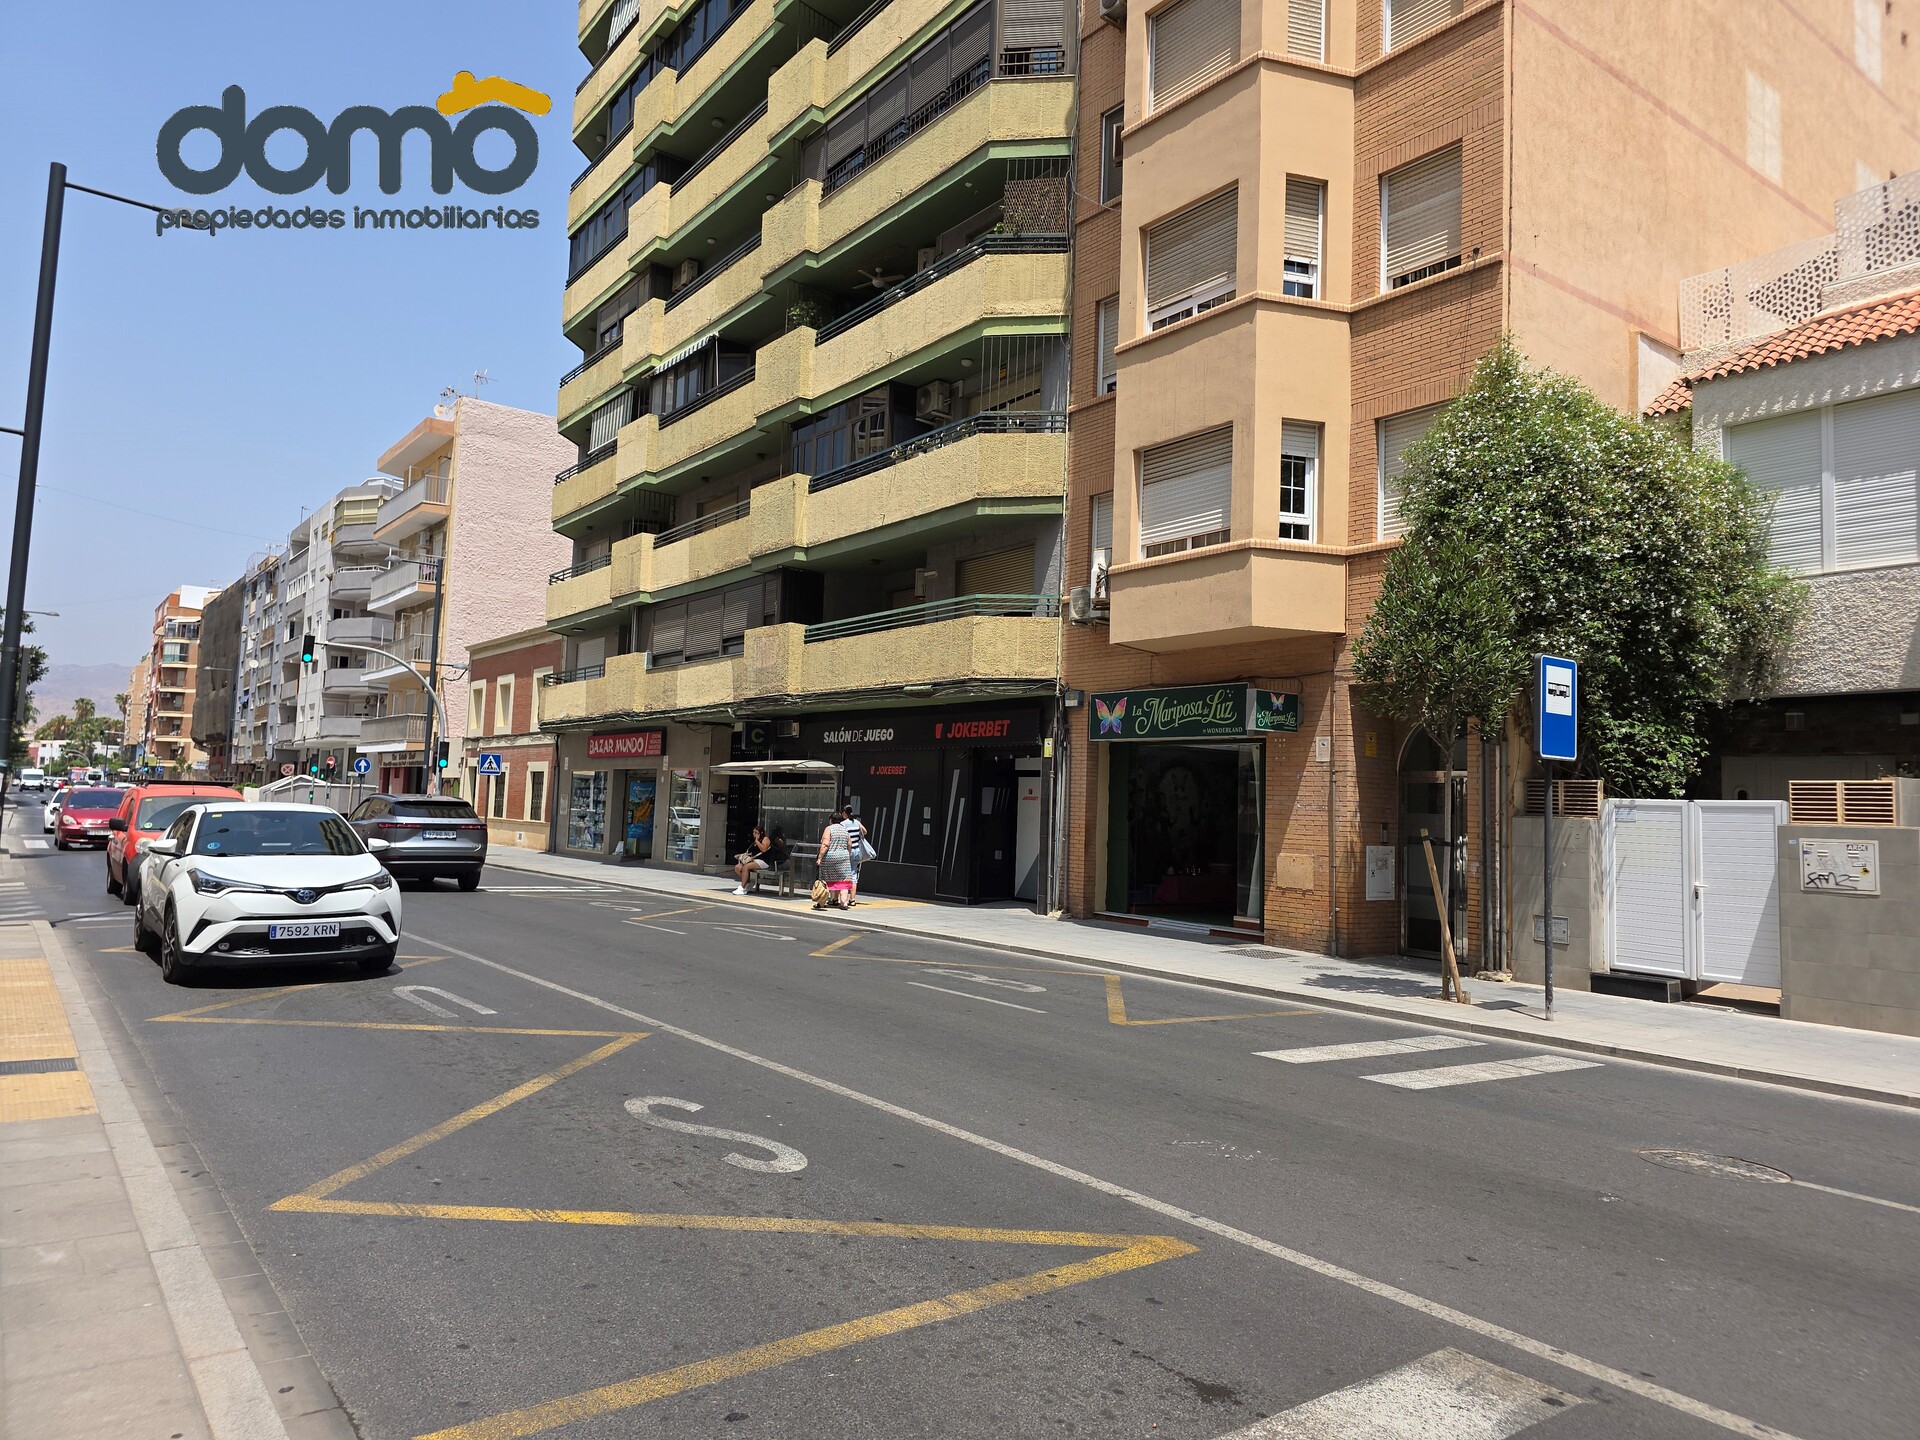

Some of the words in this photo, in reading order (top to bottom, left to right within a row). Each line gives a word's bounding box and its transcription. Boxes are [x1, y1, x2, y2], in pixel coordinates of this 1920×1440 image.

[1132, 705, 1143, 717] La
[1201, 689, 1238, 724] Luz
[1135, 696, 1203, 735] Mariposa
[823, 727, 851, 743] SALÓN
[852, 729, 863, 742] DE
[863, 728, 894, 742] JUEGO
[947, 720, 1011, 738] JOKERBET
[1207, 726, 1243, 734] WONDERLAND
[588, 738, 614, 755] BAZAR
[614, 737, 644, 754] MUNDO
[876, 766, 907, 775] JOKERBET
[279, 925, 310, 937] 7592
[313, 924, 337, 936] KRN
